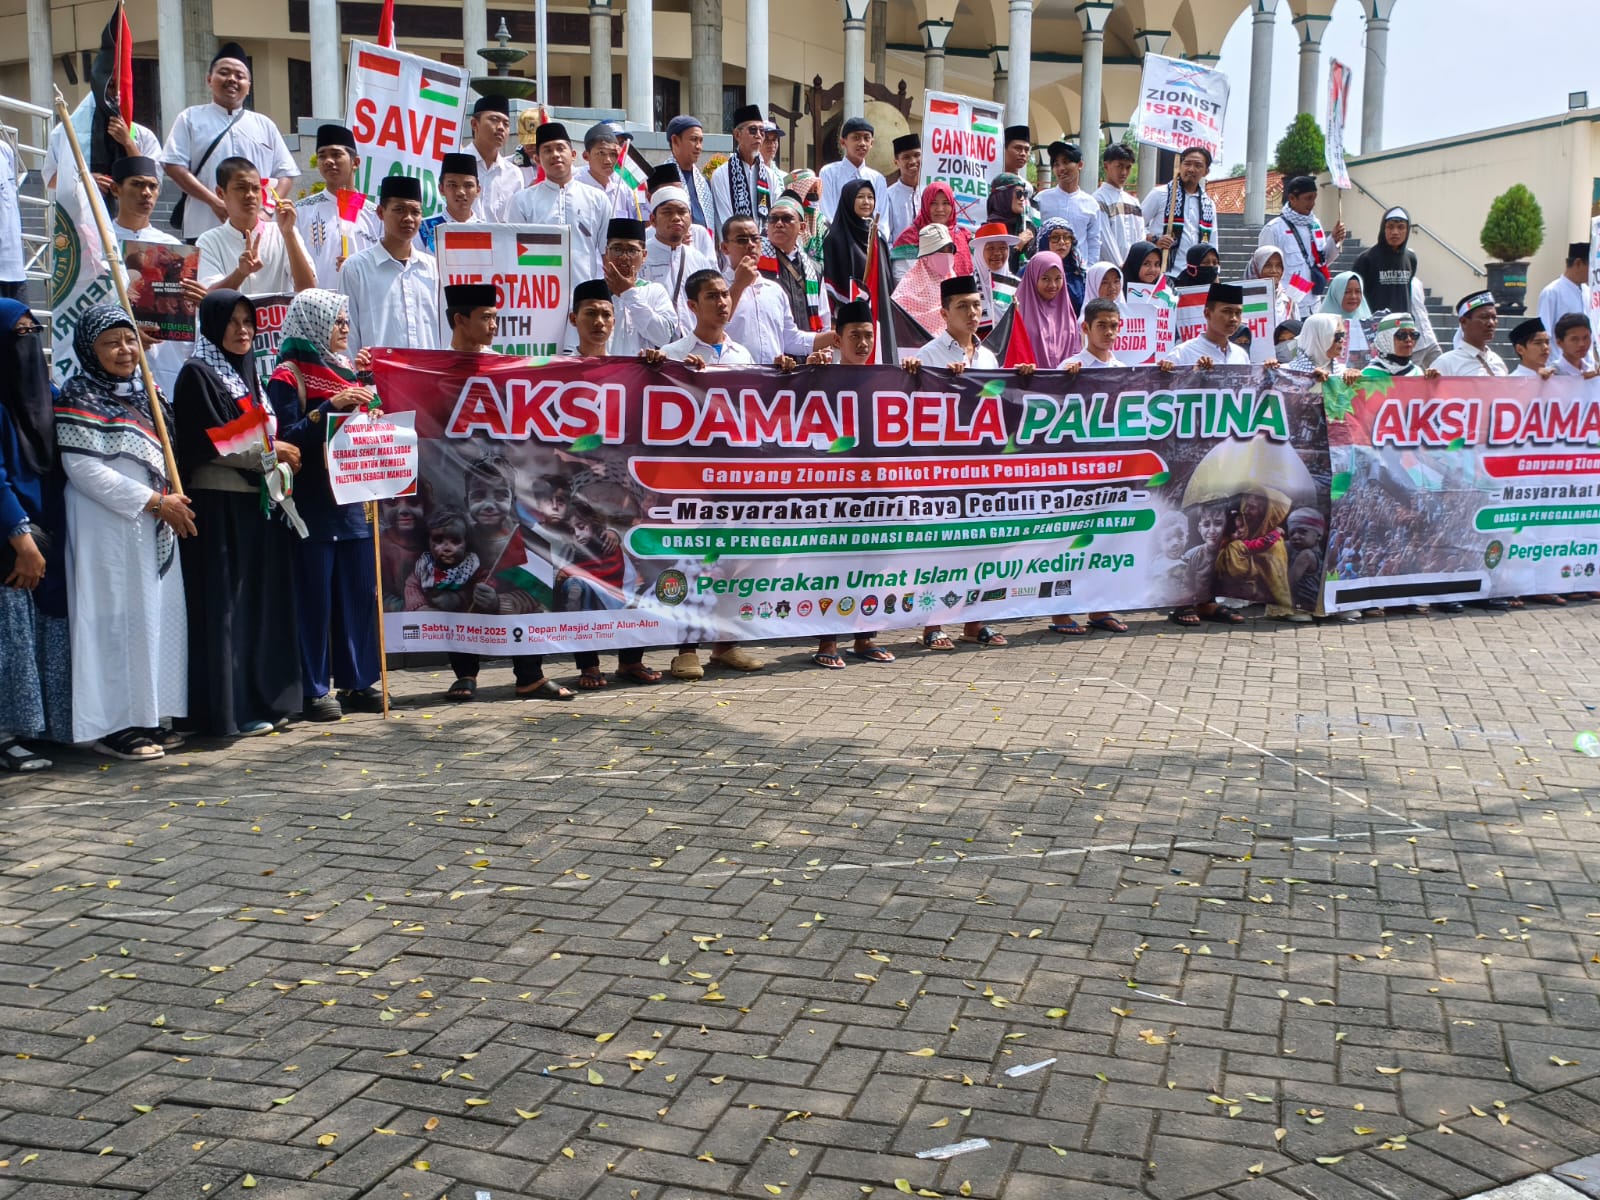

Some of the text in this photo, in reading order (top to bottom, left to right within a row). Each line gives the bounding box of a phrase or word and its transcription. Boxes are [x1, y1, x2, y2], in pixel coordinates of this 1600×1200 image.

[1146, 88, 1221, 116] ZIONIST
[352, 98, 457, 162] SAVE
[1146, 102, 1219, 131] ISRAEL
[1172, 119, 1193, 133] IS
[931, 127, 997, 163] GANYANG
[937, 157, 988, 179] ZIONIST
[491, 274, 561, 309] STAND
[495, 316, 532, 336] ITH
[448, 379, 1289, 444] AKSI DAMAI BELA PALESTINA
[1374, 401, 1481, 443] AKSI
[702, 459, 1122, 485] Ganyang Zionis & Boikot Produk Penjajah Israel
[1517, 459, 1574, 472] Ganyang
[677, 489, 1128, 522] Masyarakat Kediri Raya Peduli Palestina
[1502, 484, 1593, 500] Masyarakat
[1493, 512, 1520, 523] ORASI
[661, 516, 1136, 548] ORASI & PENGGALANGAN DONASI BAGI WARGA GAZA & PENGUNGSI RAFAH
[1508, 541, 1598, 562] Pergerakan
[697, 572, 839, 598] Pergerakan
[847, 569, 907, 589] Umat
[913, 565, 968, 586] Islam
[974, 559, 1023, 584] (PUI)
[1026, 551, 1084, 574] Kediri
[1088, 552, 1135, 573] Raya
[421, 624, 449, 632] Sabtu
[455, 624, 465, 633] 17
[467, 625, 482, 635] Mei
[484, 627, 507, 636] 2025
[528, 625, 557, 635] Depan
[559, 623, 589, 633] Masjid
[616, 619, 659, 629] Alun-Alun
